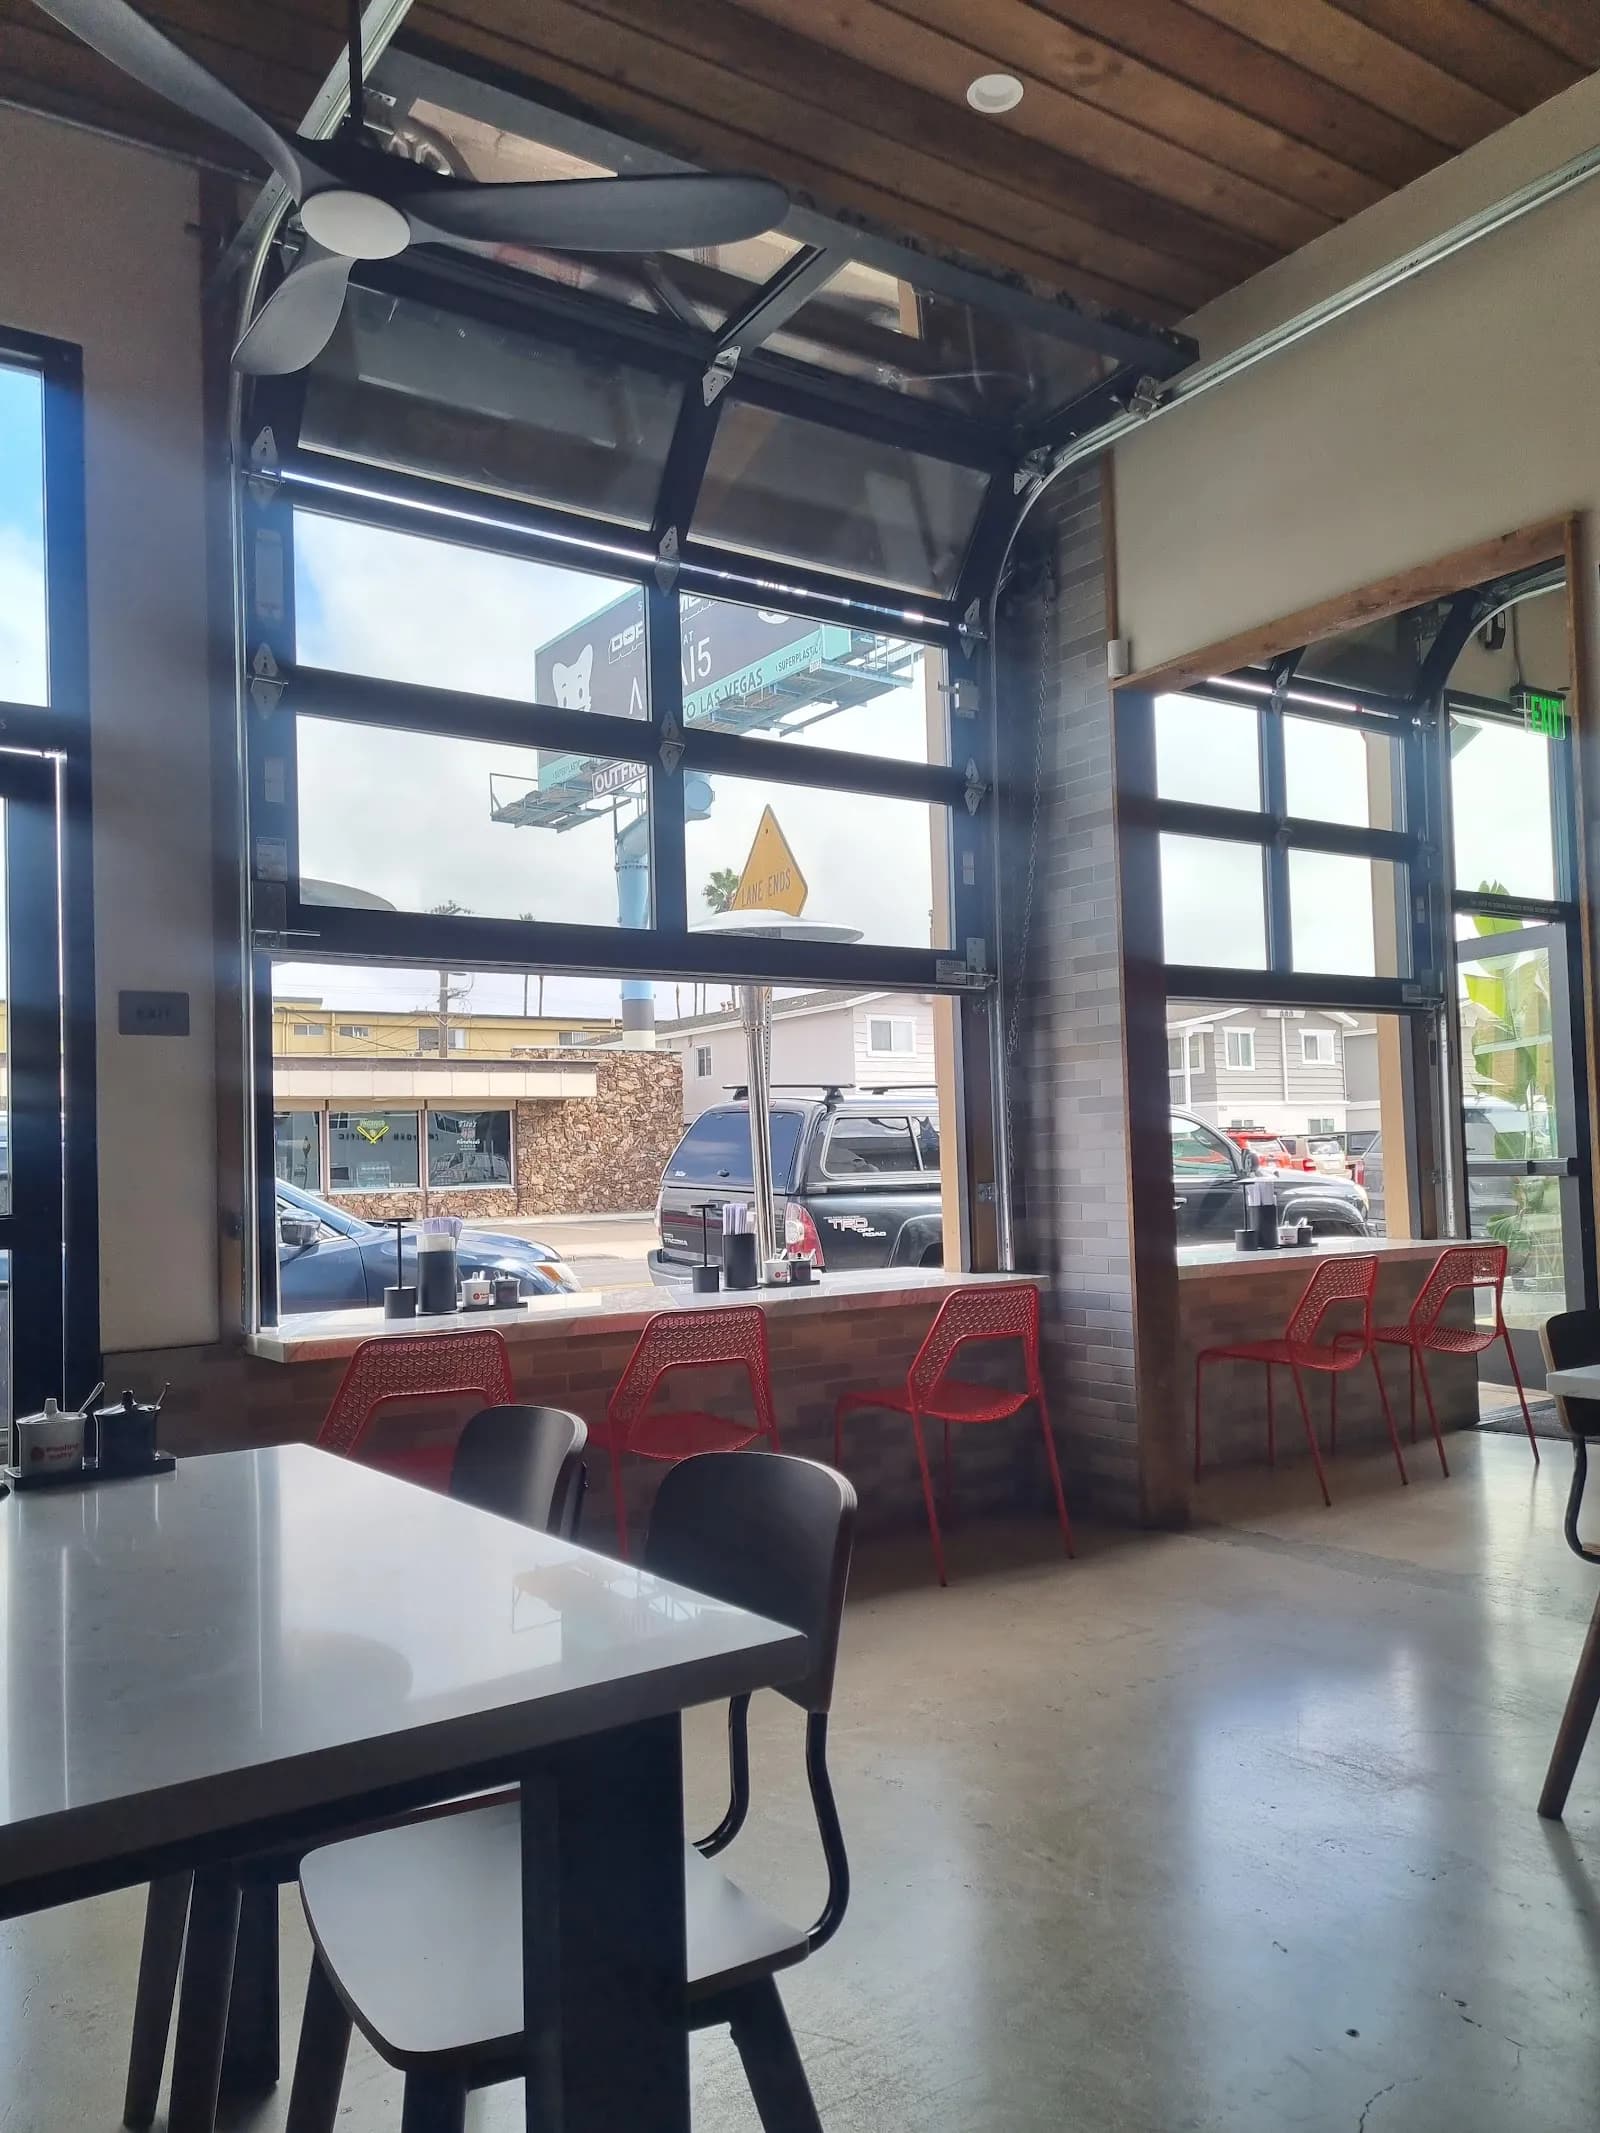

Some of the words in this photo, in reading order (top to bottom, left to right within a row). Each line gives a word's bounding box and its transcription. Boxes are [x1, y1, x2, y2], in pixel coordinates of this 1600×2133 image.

[683, 630, 694, 646] AT
[701, 689, 721, 713] LAS
[724, 668, 764, 698] VEGAS
[1530, 693, 1561, 738] EXIT
[767, 868, 792, 897] ENDS
[828, 1218, 869, 1232] TRD
